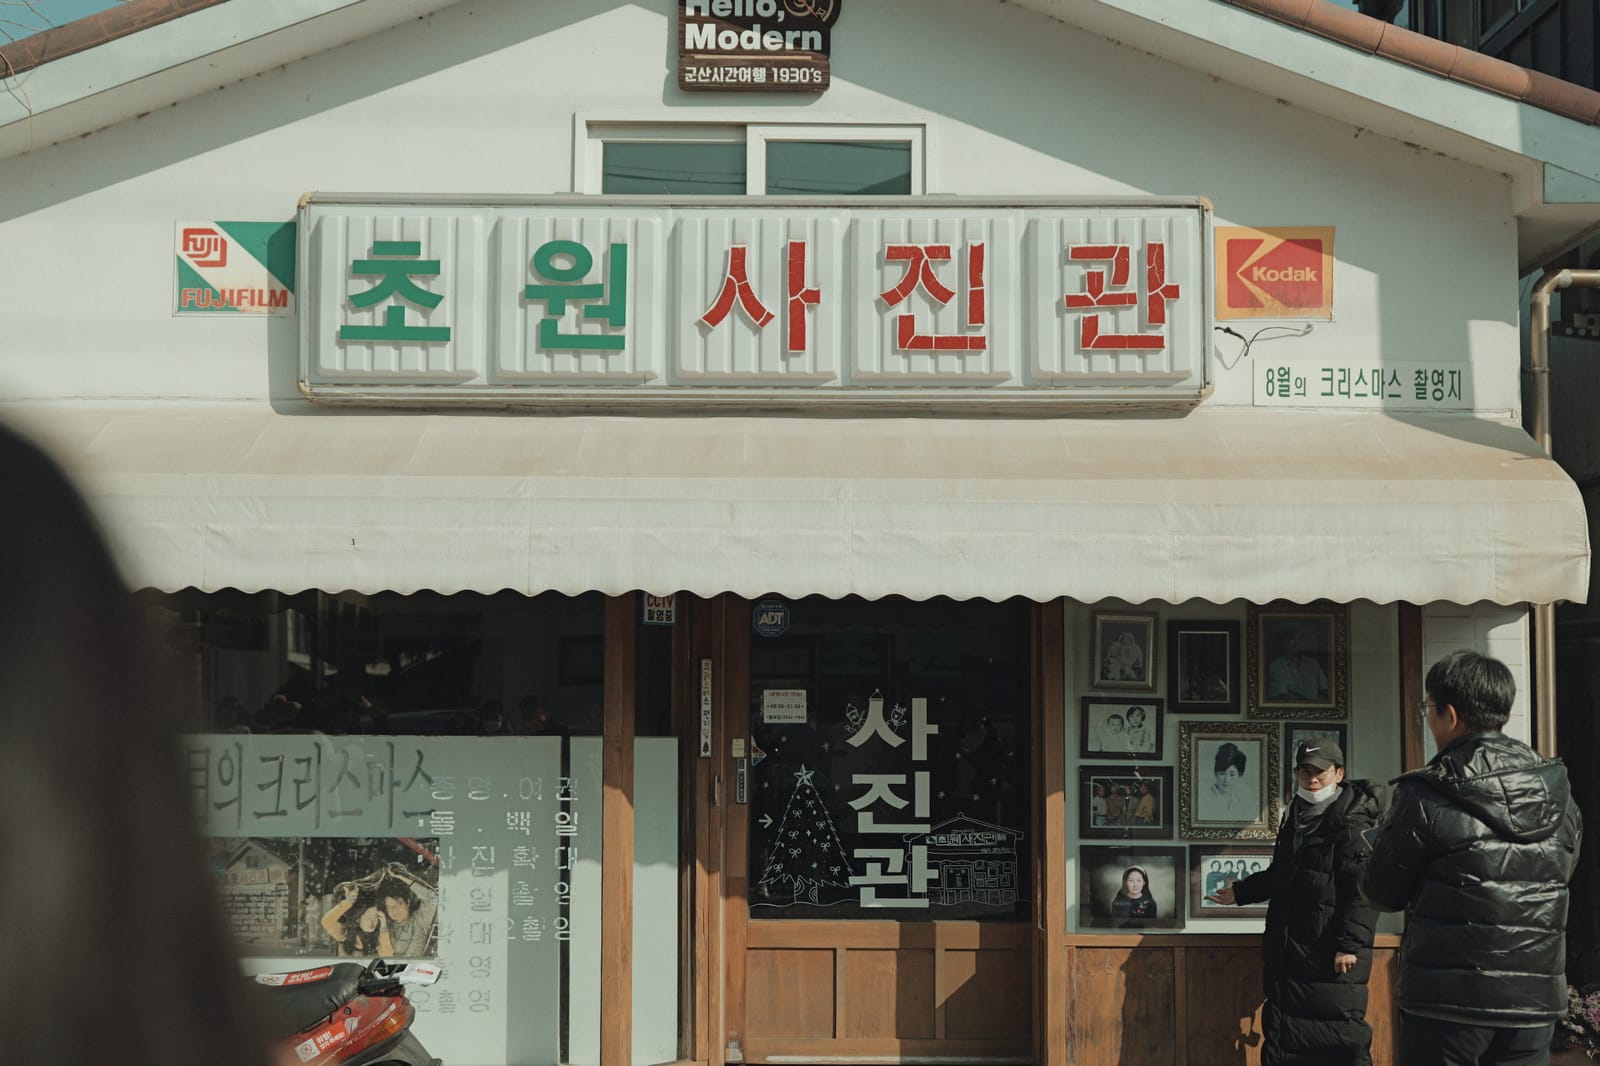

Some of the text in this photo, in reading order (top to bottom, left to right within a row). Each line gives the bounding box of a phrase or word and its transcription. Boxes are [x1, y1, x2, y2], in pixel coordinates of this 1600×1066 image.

[685, 0, 785, 22] Hello,
[685, 23, 822, 50] Modern
[684, 67, 822, 83] 군산시간여행 1930's
[182, 228, 228, 268] FUJI
[1252, 267, 1318, 281] Kodak
[181, 288, 288, 308] FUJIFILM
[339, 239, 1180, 352] 초원사진관
[1266, 367, 1462, 401] 8월의 크리스마스 촬영지
[647, 592, 674, 608] CCTV
[647, 608, 673, 622] 촬영중
[758, 611, 785, 625] ADT
[845, 697, 939, 908] 사진관
